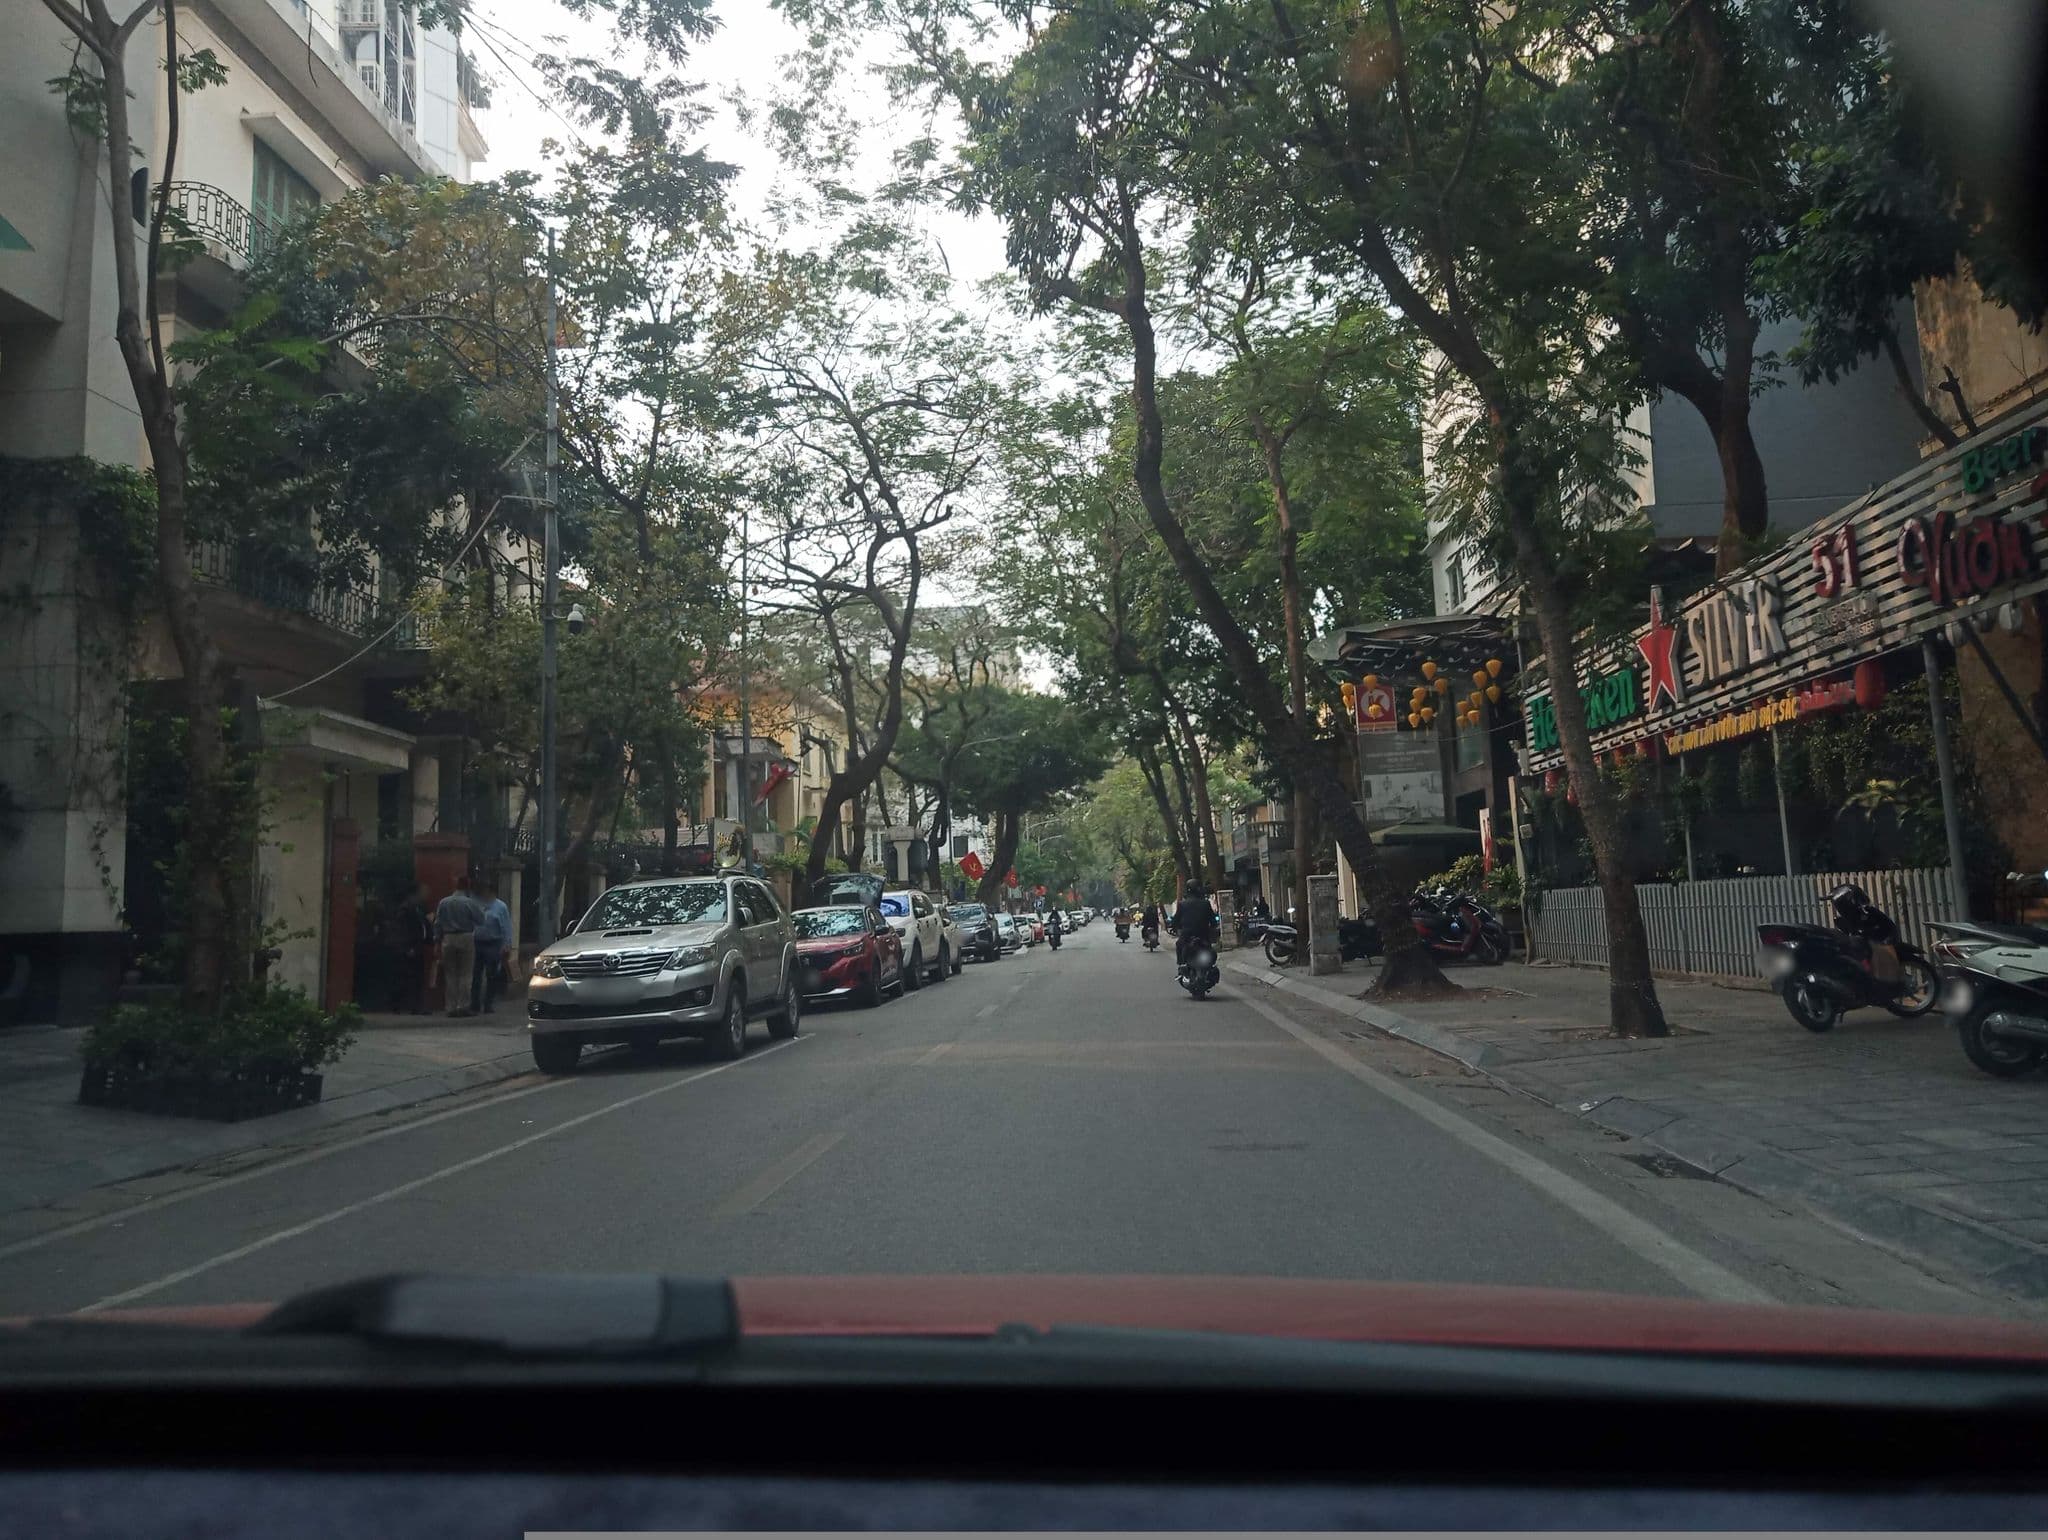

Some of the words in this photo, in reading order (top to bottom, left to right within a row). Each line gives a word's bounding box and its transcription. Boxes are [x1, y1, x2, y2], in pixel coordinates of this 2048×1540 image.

[1962, 428, 2037, 493] Beer
[1812, 524, 1857, 598] 51
[1681, 575, 1786, 688] SILVER
